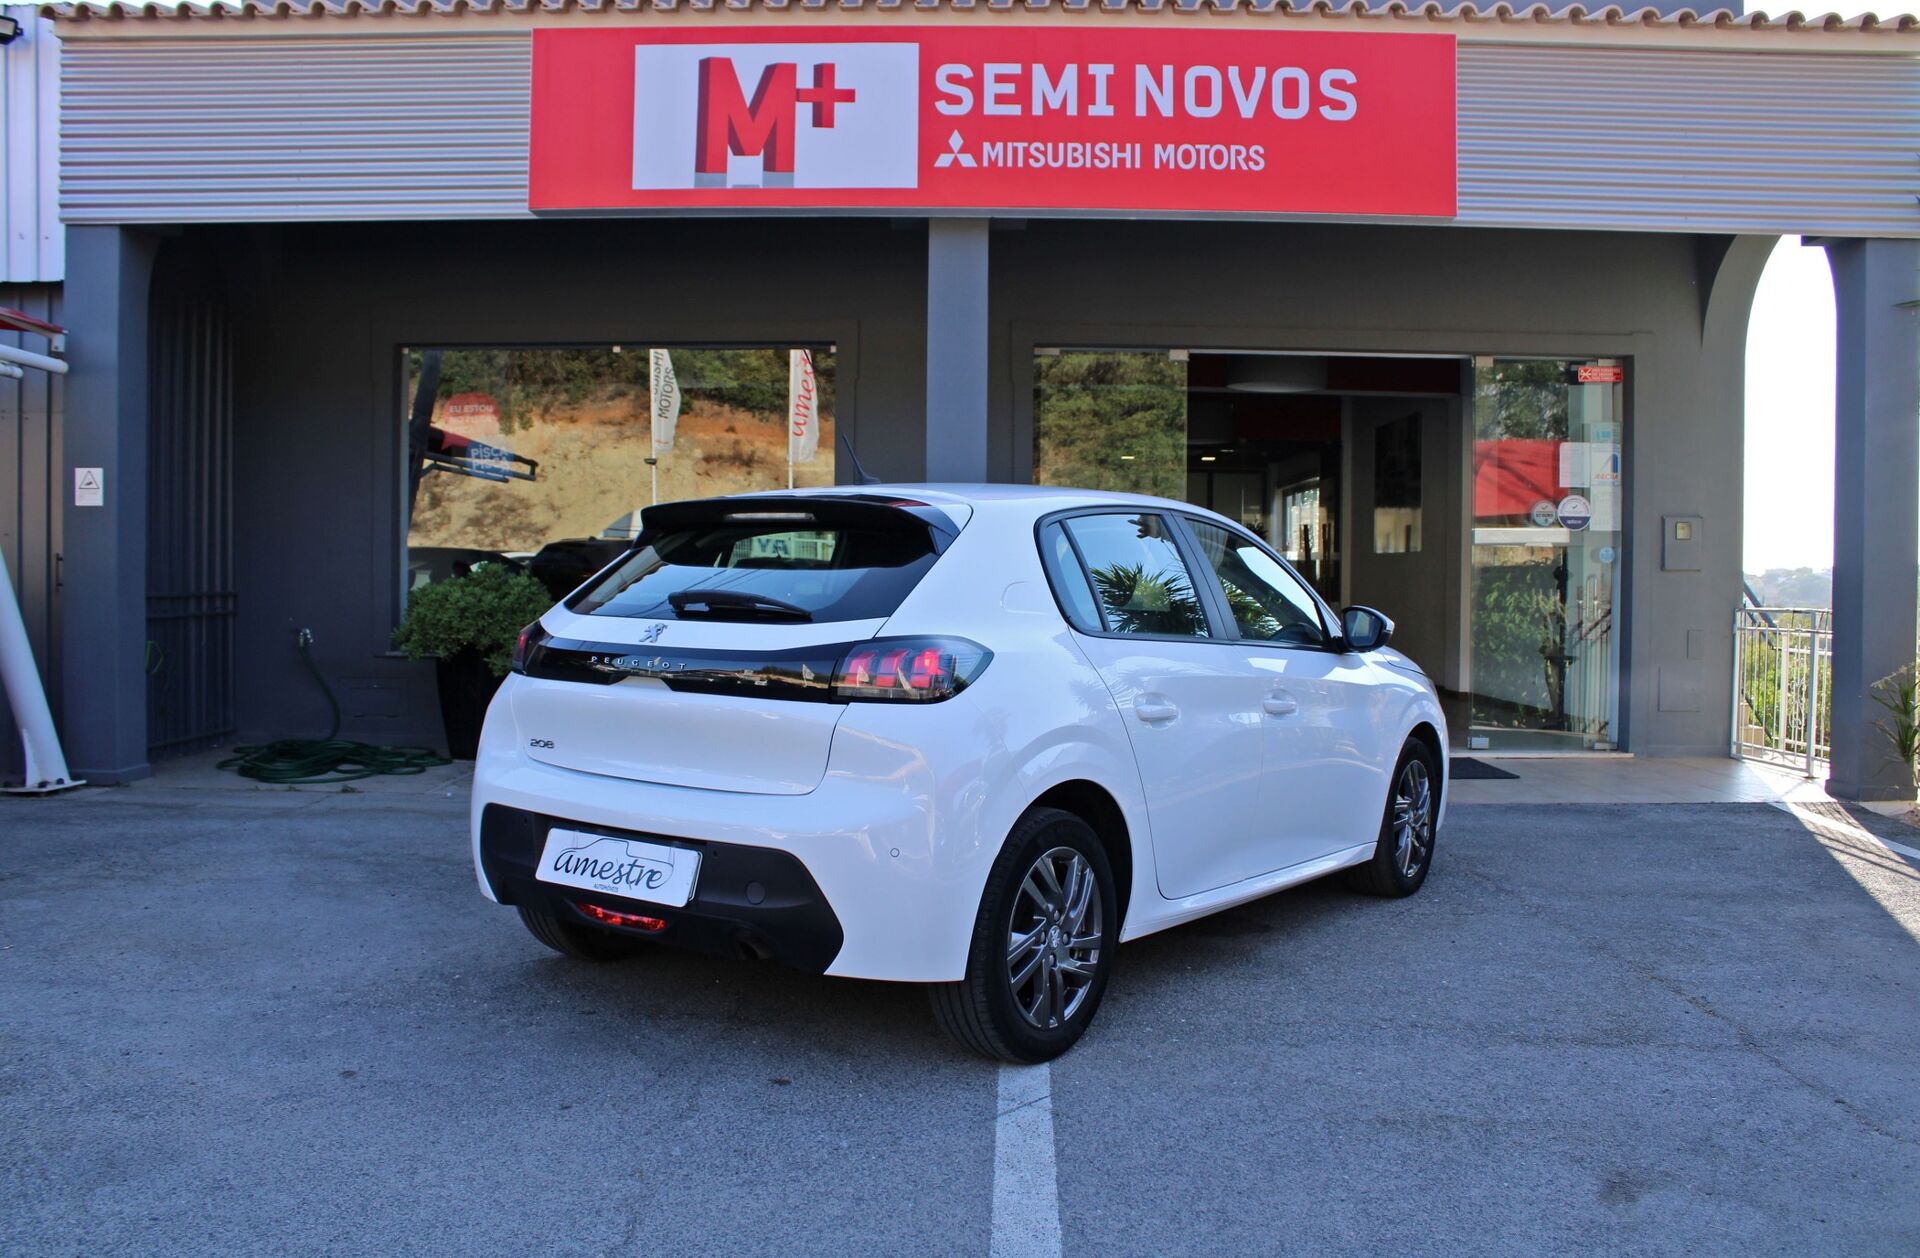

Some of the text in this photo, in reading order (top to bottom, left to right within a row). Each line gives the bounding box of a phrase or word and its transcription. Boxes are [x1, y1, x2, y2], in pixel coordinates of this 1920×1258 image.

[934, 63, 1358, 121] SEMI NOVOS
[982, 141, 1266, 171] MITSUBISHI MOTORS
[658, 366, 677, 419] MOTORS
[591, 655, 686, 670] PEUGEOT
[530, 738, 554, 749] 208
[554, 851, 662, 889] amestre
